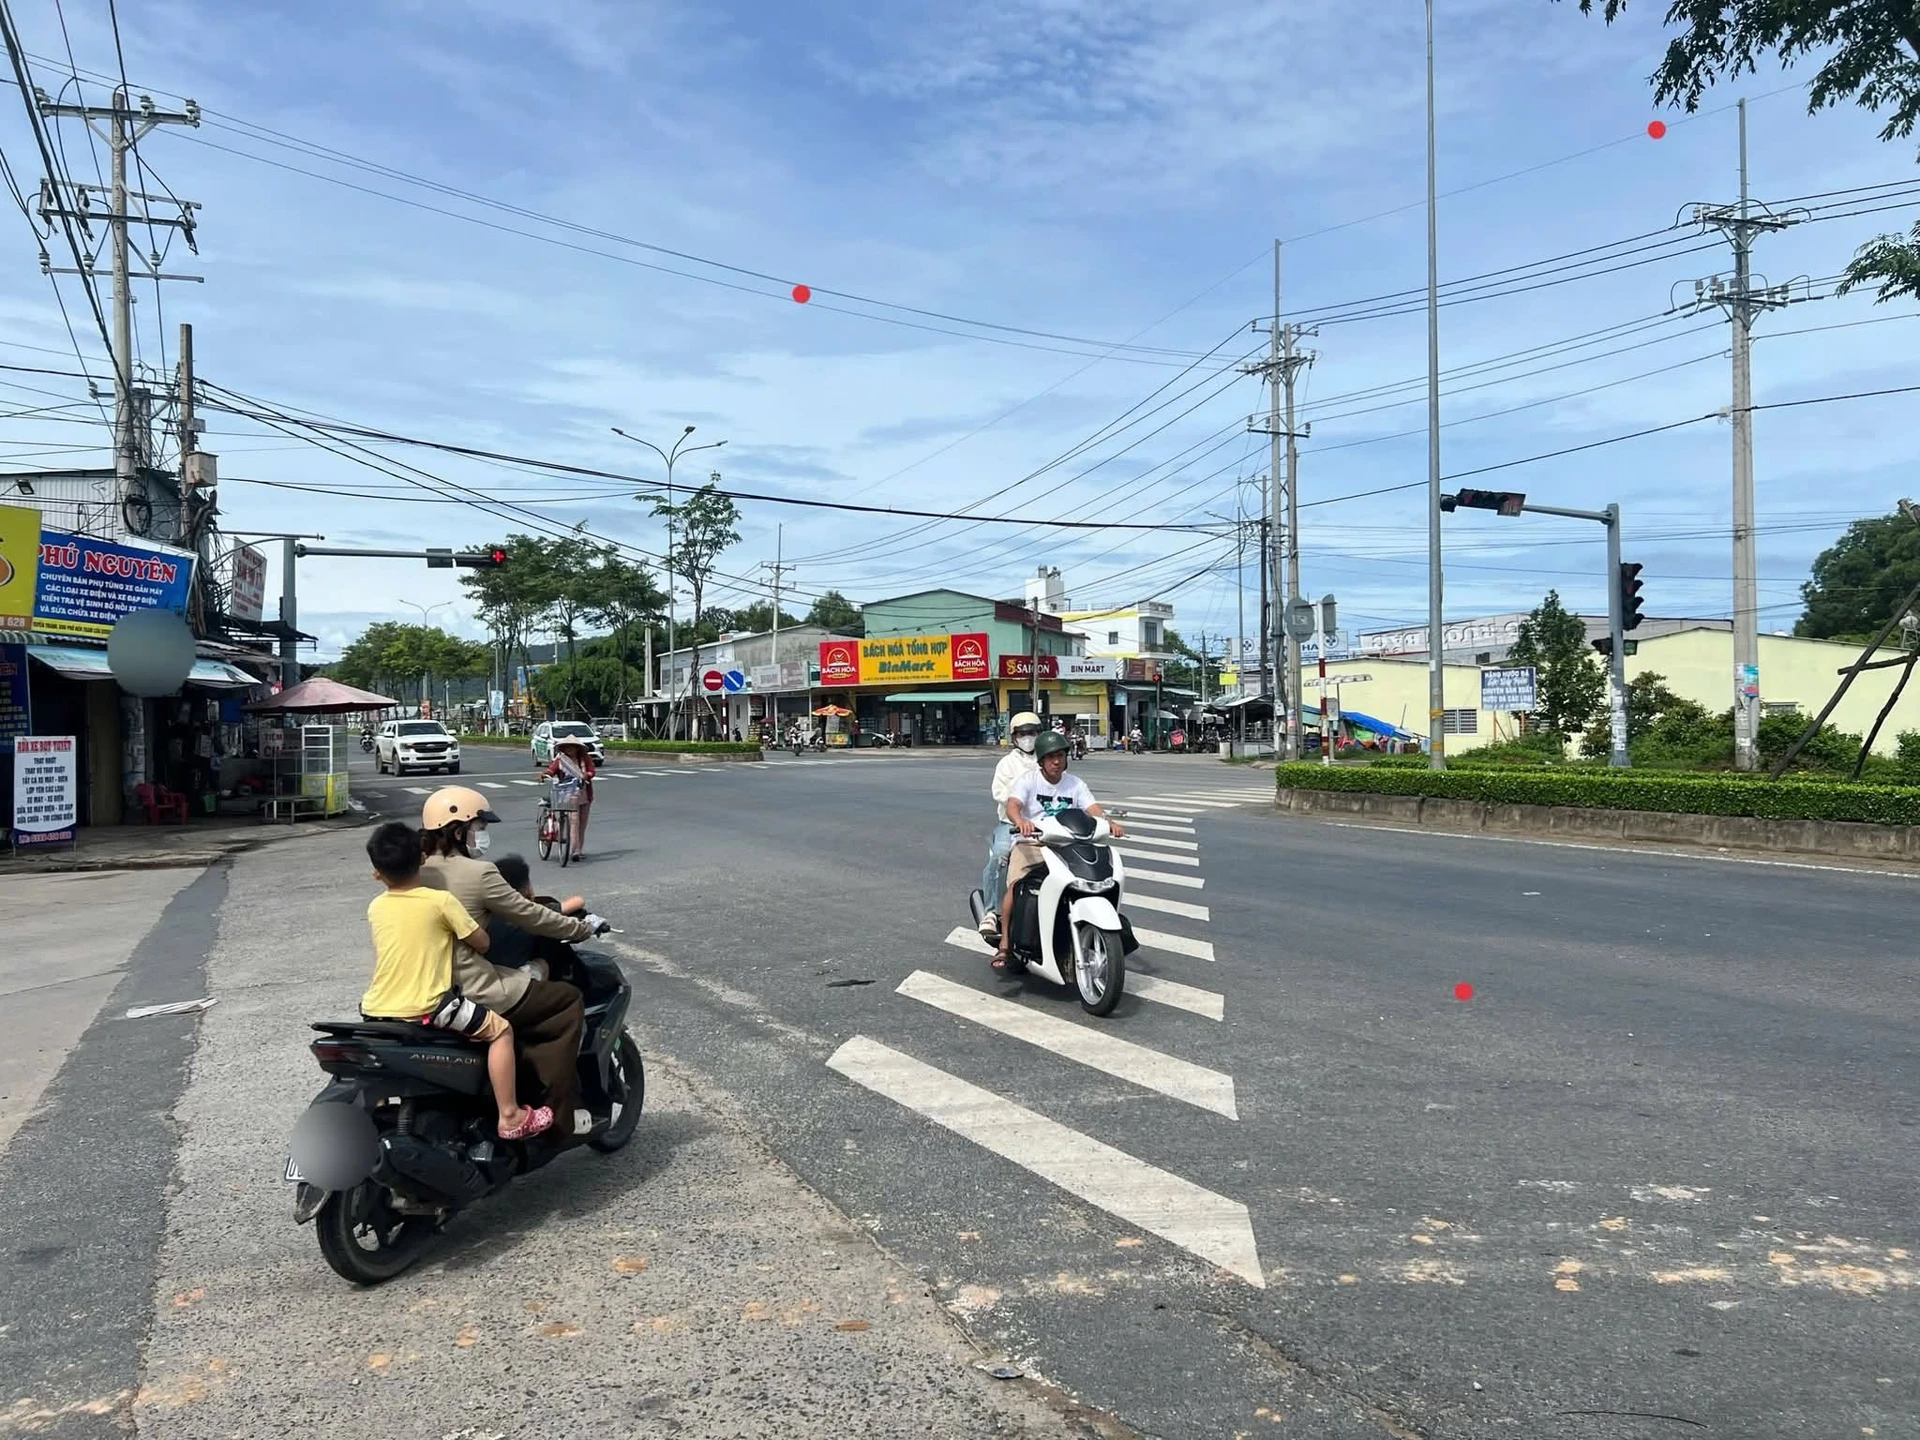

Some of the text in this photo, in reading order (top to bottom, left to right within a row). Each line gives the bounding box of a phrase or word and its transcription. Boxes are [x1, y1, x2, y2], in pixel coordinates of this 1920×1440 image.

[83, 550, 178, 584] NGUYÊN
[40, 572, 72, 584] CHUYÊN
[73, 576, 88, 585] BÁN
[88, 579, 105, 588] PHỤ
[105, 580, 124, 591] TÙNG
[149, 586, 163, 595] MÁY
[45, 583, 61, 593] CÁC
[62, 586, 78, 596] LOẠI
[89, 588, 107, 599] ĐIỆN
[107, 590, 117, 599] VÀ
[118, 593, 127, 601] XE
[127, 594, 141, 604] ĐẠP
[60, 596, 75, 604] TRA
[75, 598, 85, 607] VỆ
[86, 600, 103, 609] SINH
[40, 603, 50, 613] VÀ
[89, 610, 98, 618] XE
[863, 642, 886, 658] BÁCH
[887, 641, 904, 657] HÓA
[930, 641, 948, 658] HỢP
[821, 666, 841, 674] BÁCH
[878, 659, 935, 674] BinMark
[953, 659, 971, 668] BÁCH
[1016, 663, 1050, 675] SAION
[1070, 664, 1105, 674] BIN MART
